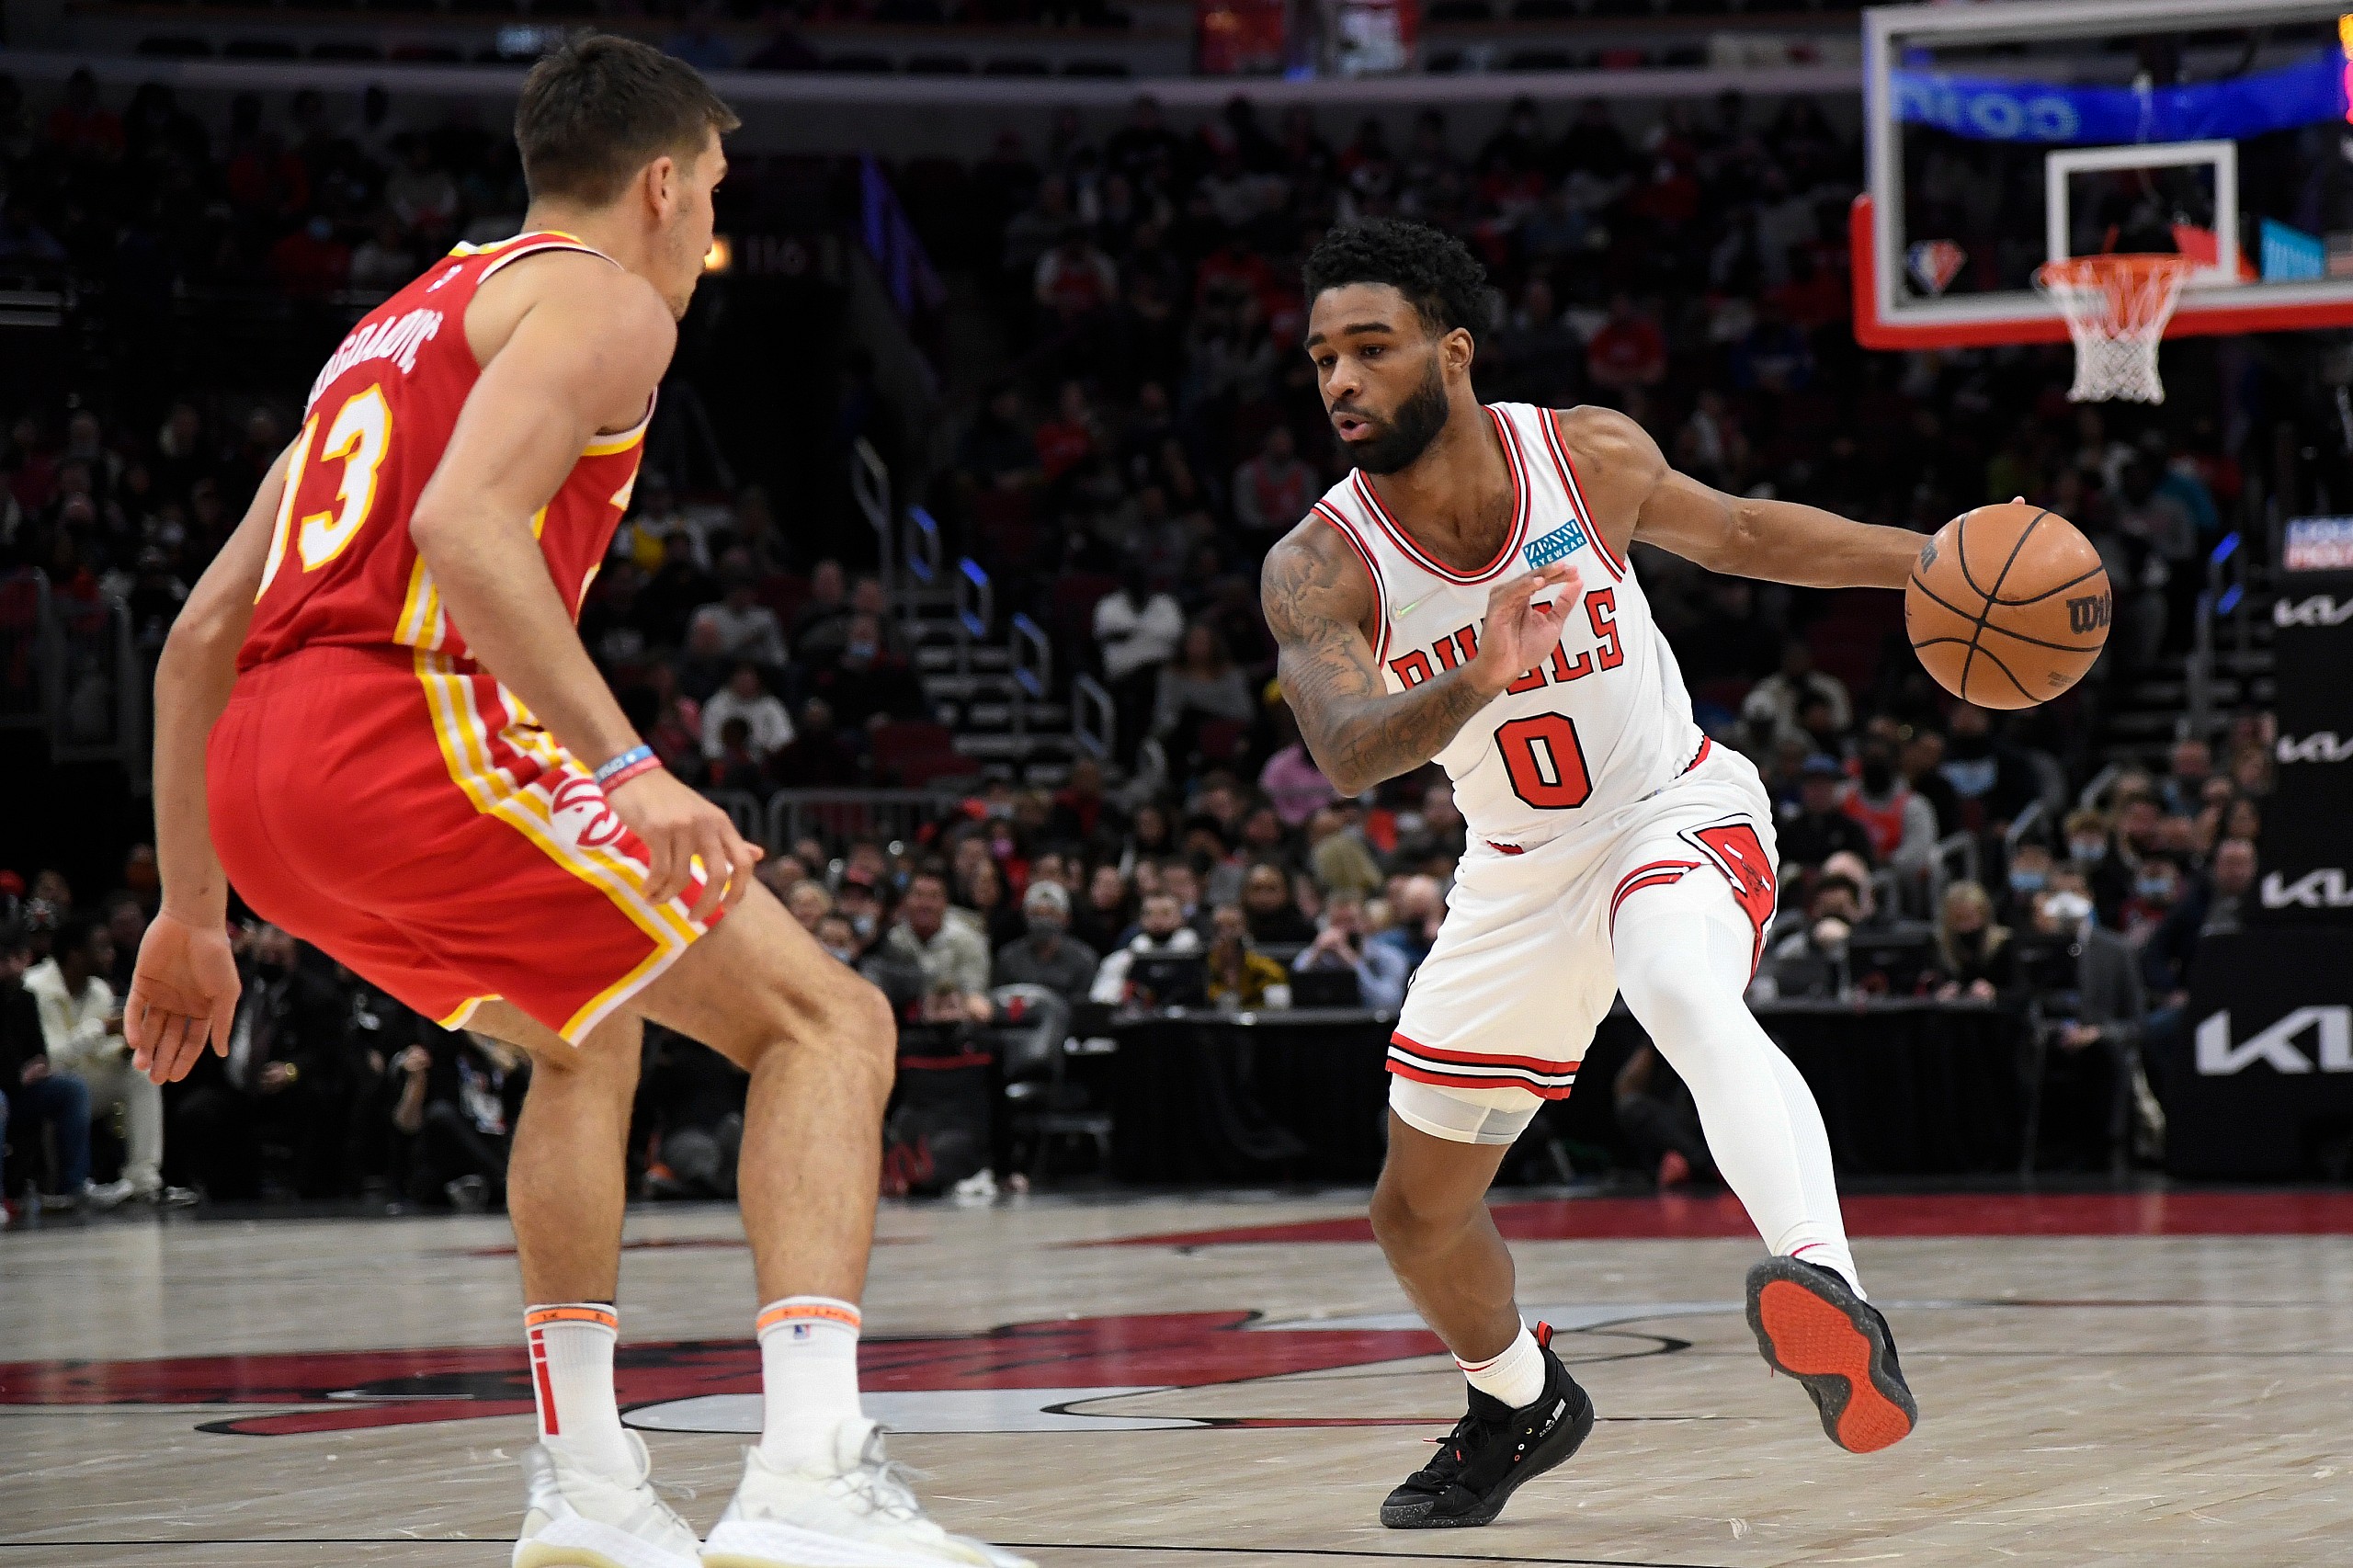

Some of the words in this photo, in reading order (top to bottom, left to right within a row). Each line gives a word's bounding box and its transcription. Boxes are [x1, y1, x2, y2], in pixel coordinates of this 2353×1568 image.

[254, 382, 393, 605] 13
[1524, 521, 1579, 560] ZENNI
[1531, 537, 1584, 570] EYEWEAR
[1494, 711, 1593, 809] 0
